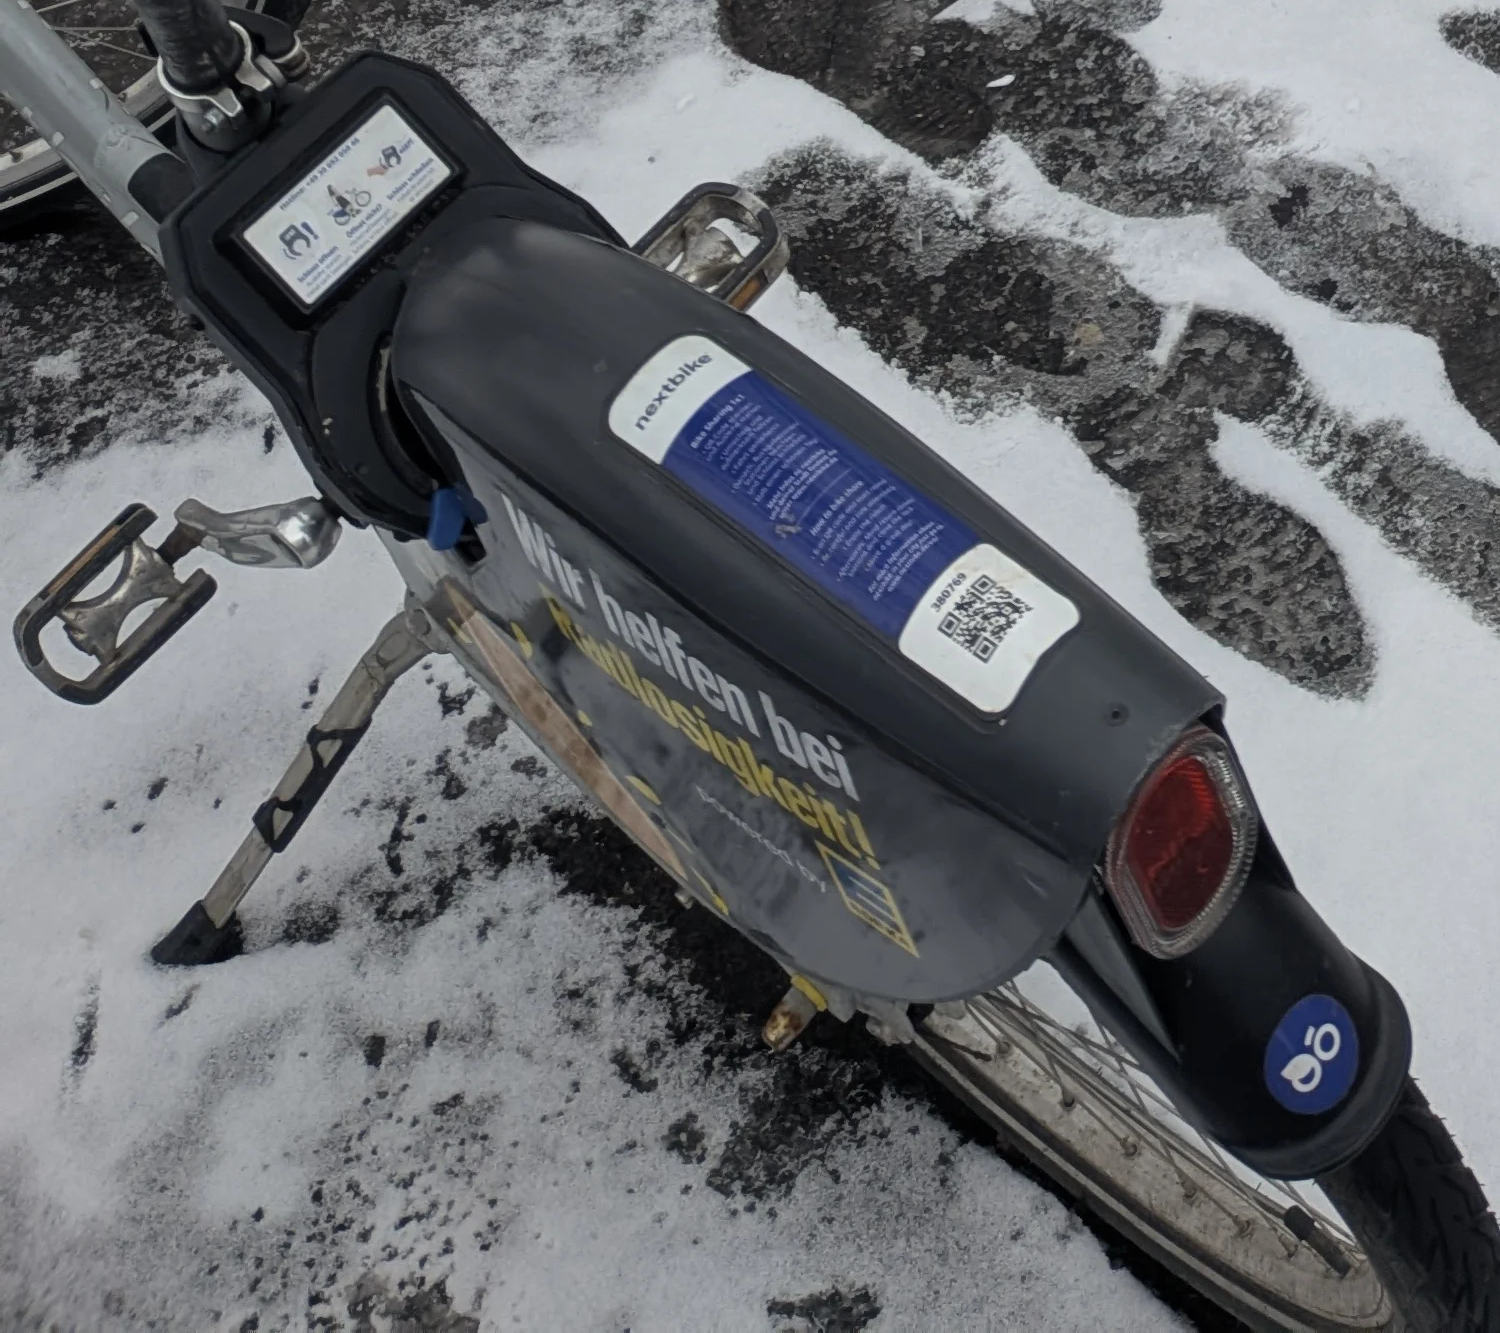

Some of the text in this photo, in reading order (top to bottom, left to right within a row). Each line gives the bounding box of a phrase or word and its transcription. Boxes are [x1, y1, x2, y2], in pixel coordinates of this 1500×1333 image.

[634, 351, 714, 432] nextbike
[691, 431, 707, 449] Bike
[705, 404, 733, 433] Sharing
[810, 480, 864, 536] How to bike share
[930, 572, 967, 613] 380769
[501, 493, 861, 802] Wir helfen bei
[540, 581, 881, 871] Radlosigkeit!
